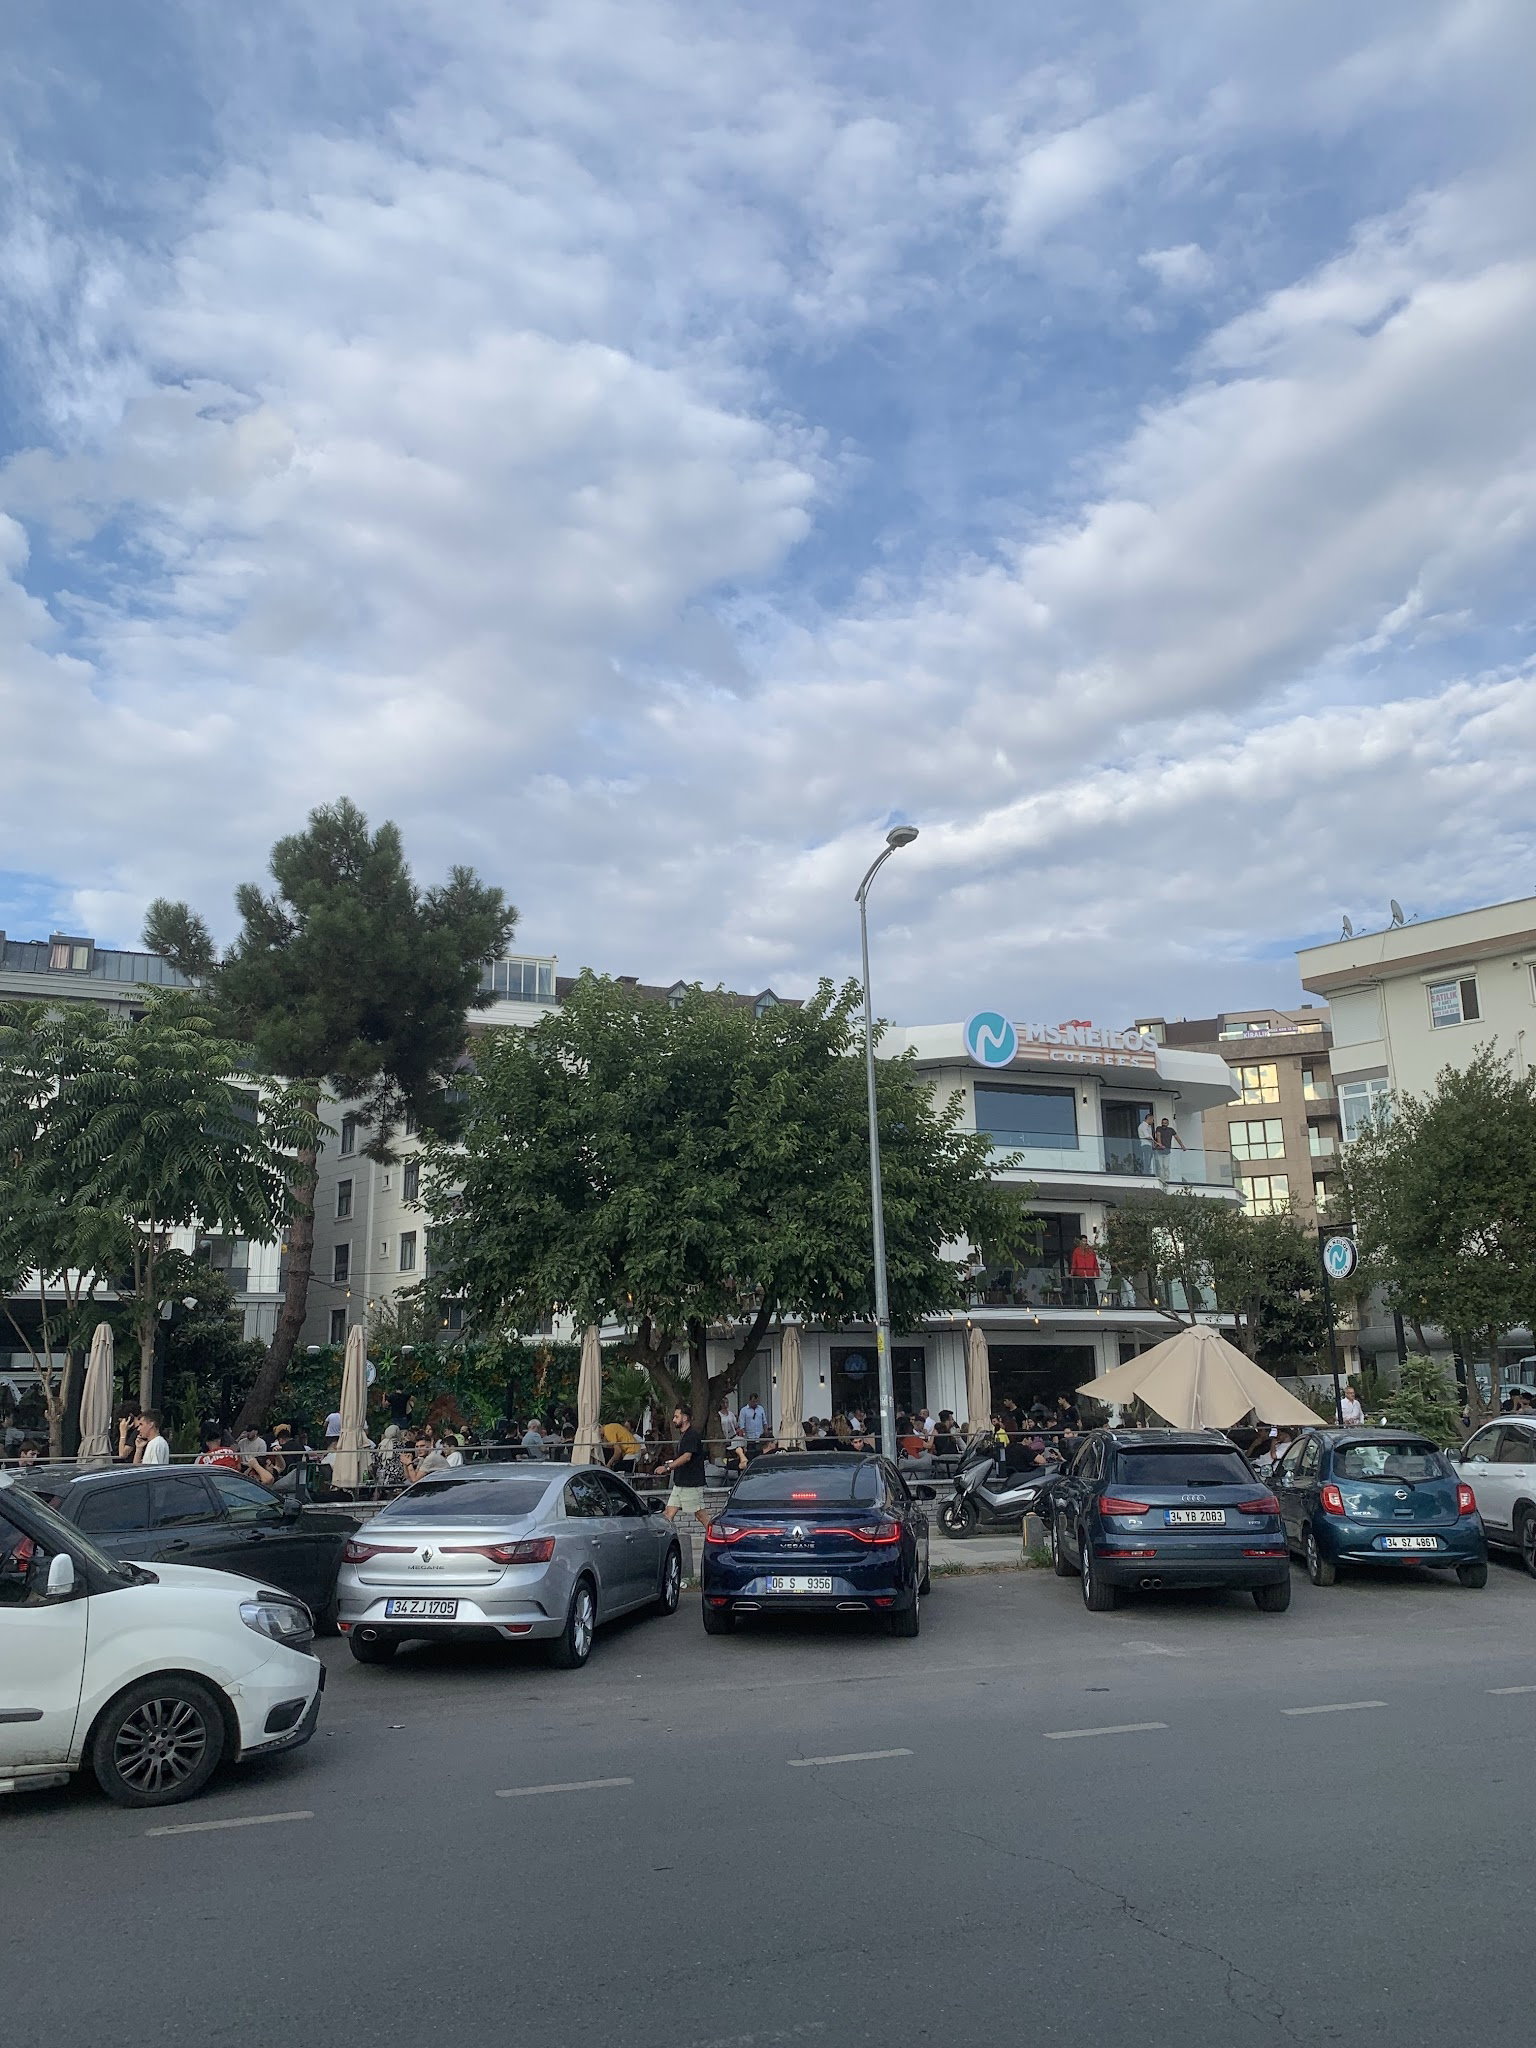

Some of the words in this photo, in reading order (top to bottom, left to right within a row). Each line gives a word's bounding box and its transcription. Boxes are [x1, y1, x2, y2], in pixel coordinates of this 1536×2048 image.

[1171, 1511, 1182, 1522] 34
[1185, 1511, 1197, 1522] YB
[1200, 1511, 1223, 1521] 2083
[1387, 1538, 1397, 1547] 34
[1401, 1538, 1412, 1547] SZ
[772, 1577, 784, 1589] 06
[789, 1577, 796, 1589] S
[807, 1578, 831, 1589] 9356
[394, 1600, 408, 1613] 34
[410, 1601, 427, 1613] ZJ
[429, 1601, 455, 1614] 1705
